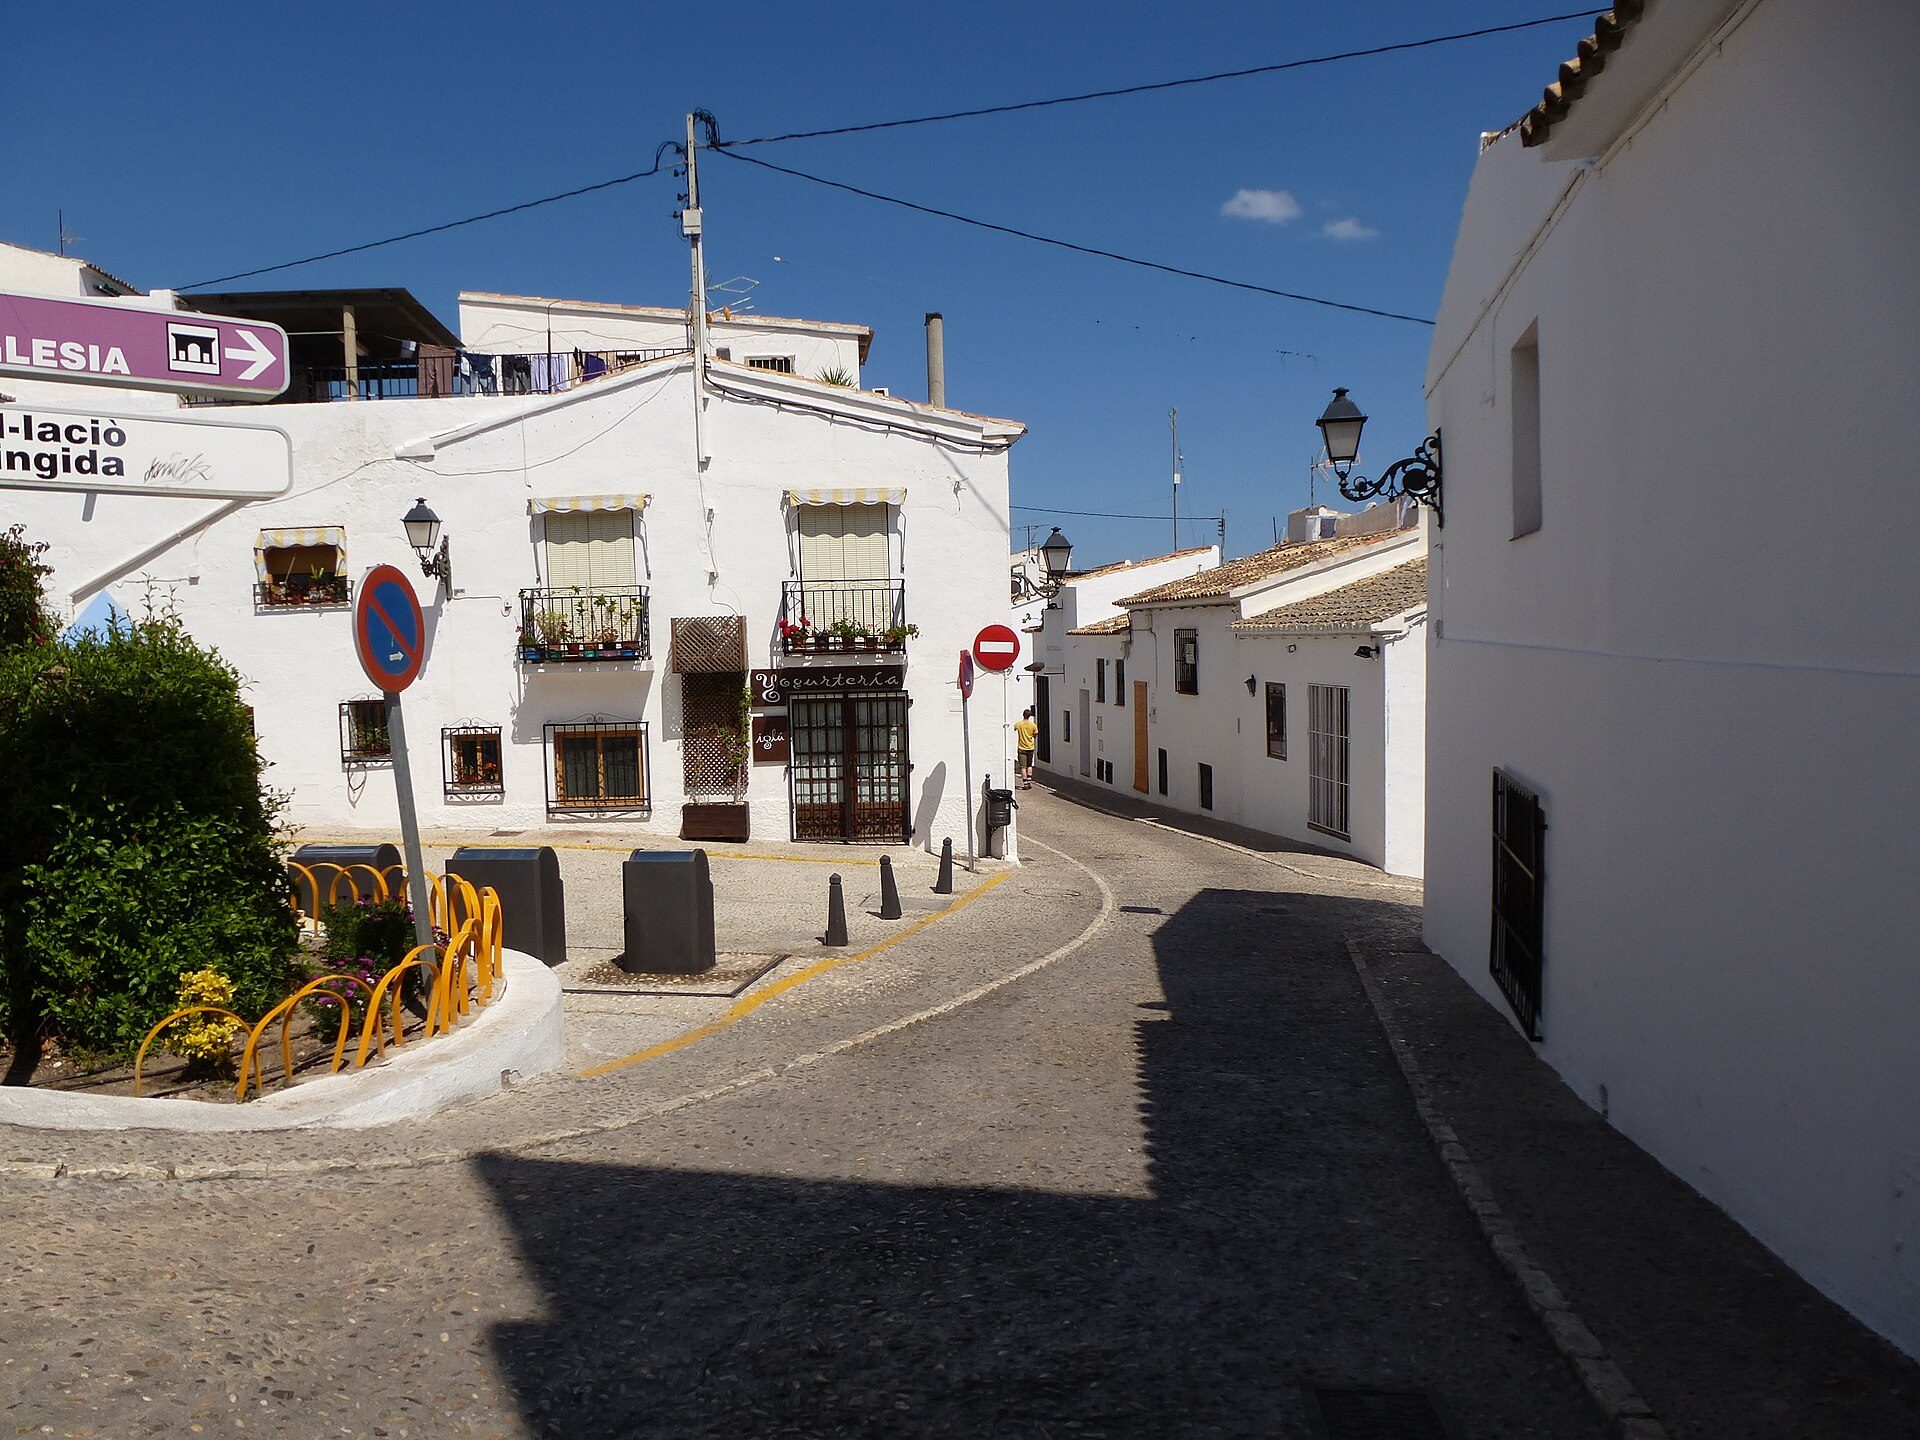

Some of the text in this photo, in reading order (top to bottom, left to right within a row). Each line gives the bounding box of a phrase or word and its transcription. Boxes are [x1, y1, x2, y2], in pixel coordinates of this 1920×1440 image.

[0, 335, 131, 375] LESIA
[0, 444, 125, 480] ngida
[755, 671, 899, 703] Yogurtería
